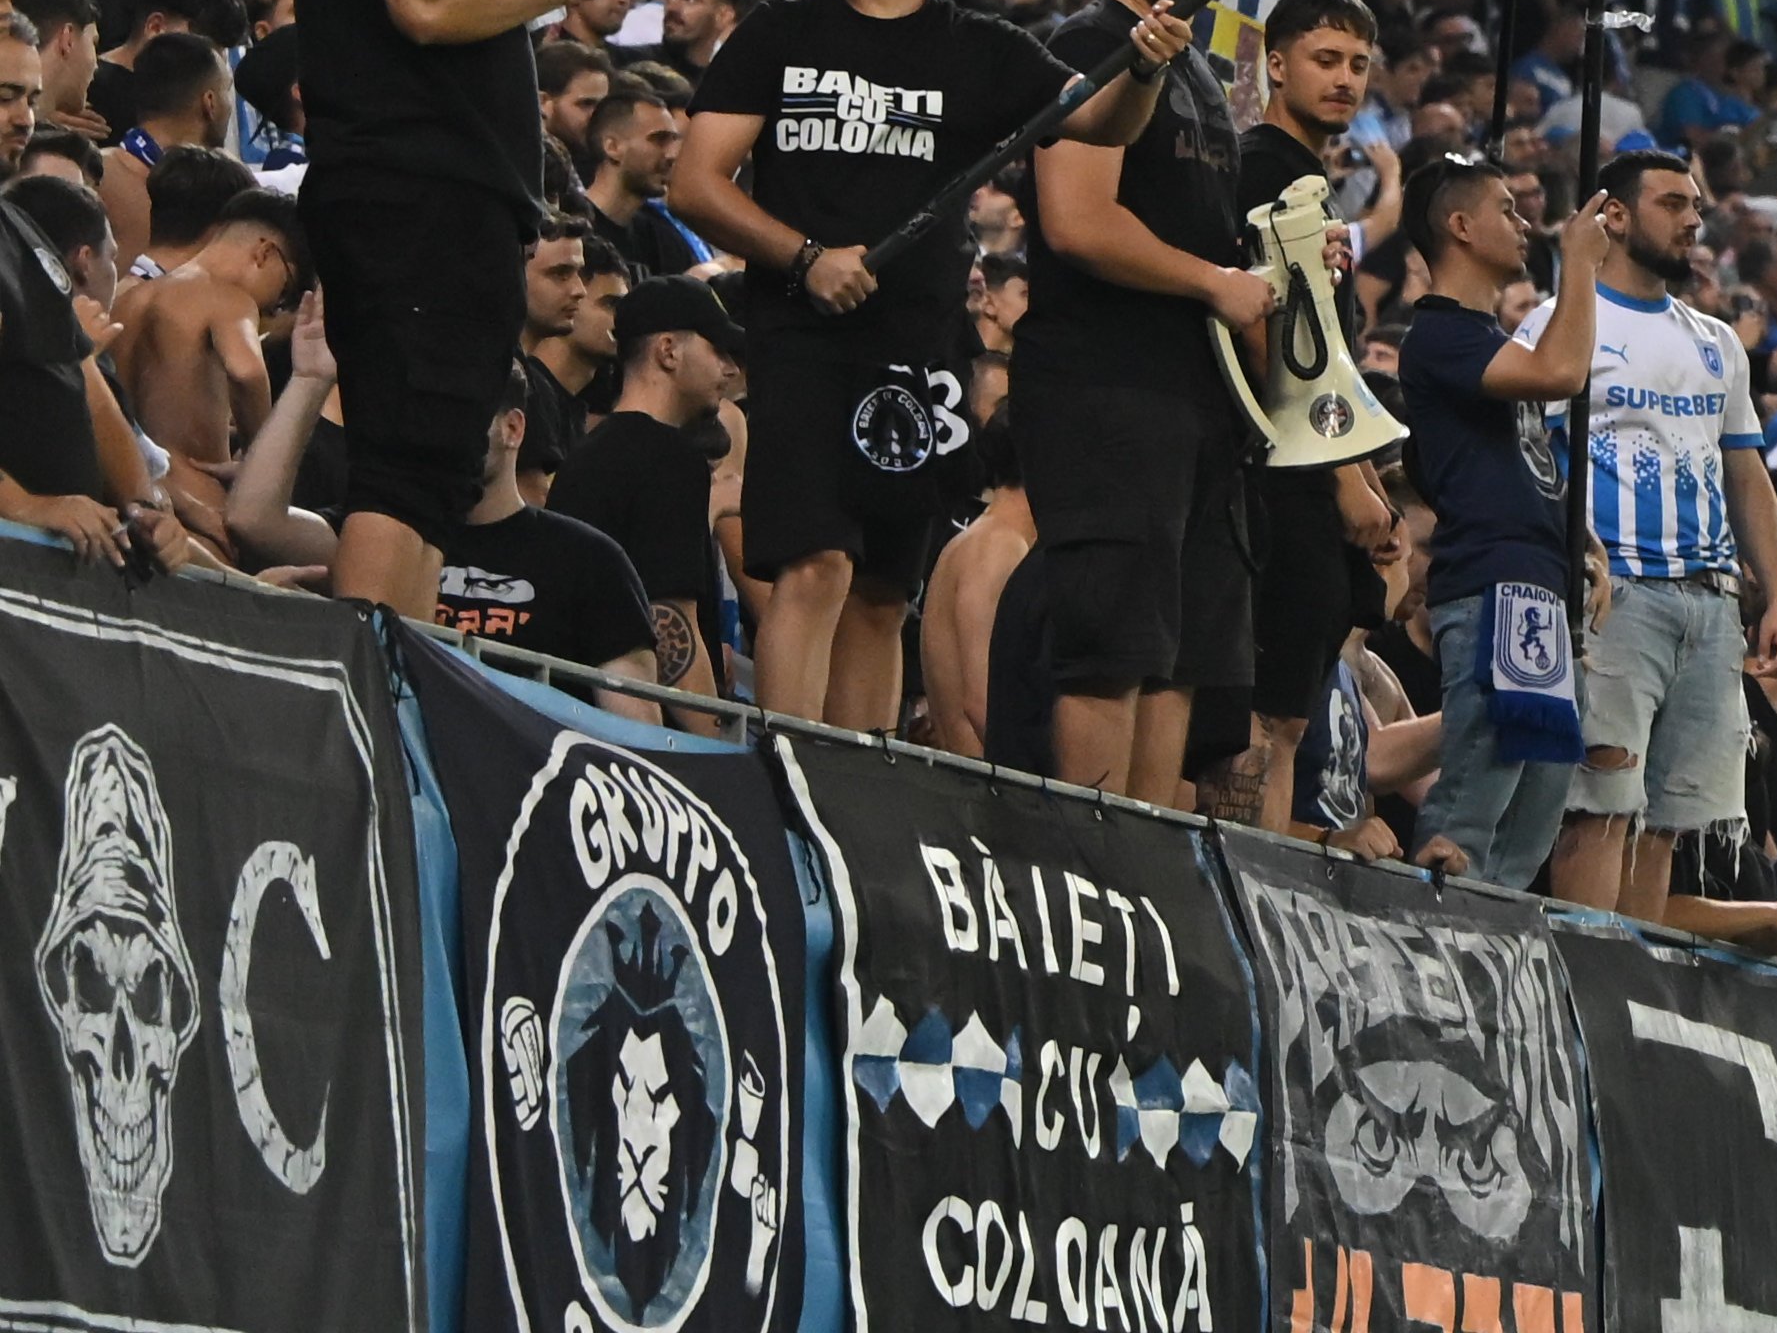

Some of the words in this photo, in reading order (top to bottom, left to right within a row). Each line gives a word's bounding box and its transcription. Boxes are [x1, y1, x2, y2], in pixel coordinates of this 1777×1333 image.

[783, 66, 943, 116] BAIETI
[837, 93, 887, 124] CU
[777, 117, 935, 162] COLOANA
[1605, 385, 1727, 417] SUPERBET
[568, 763, 737, 957] GRUPPO
[1039, 1038, 1102, 1161] CU
